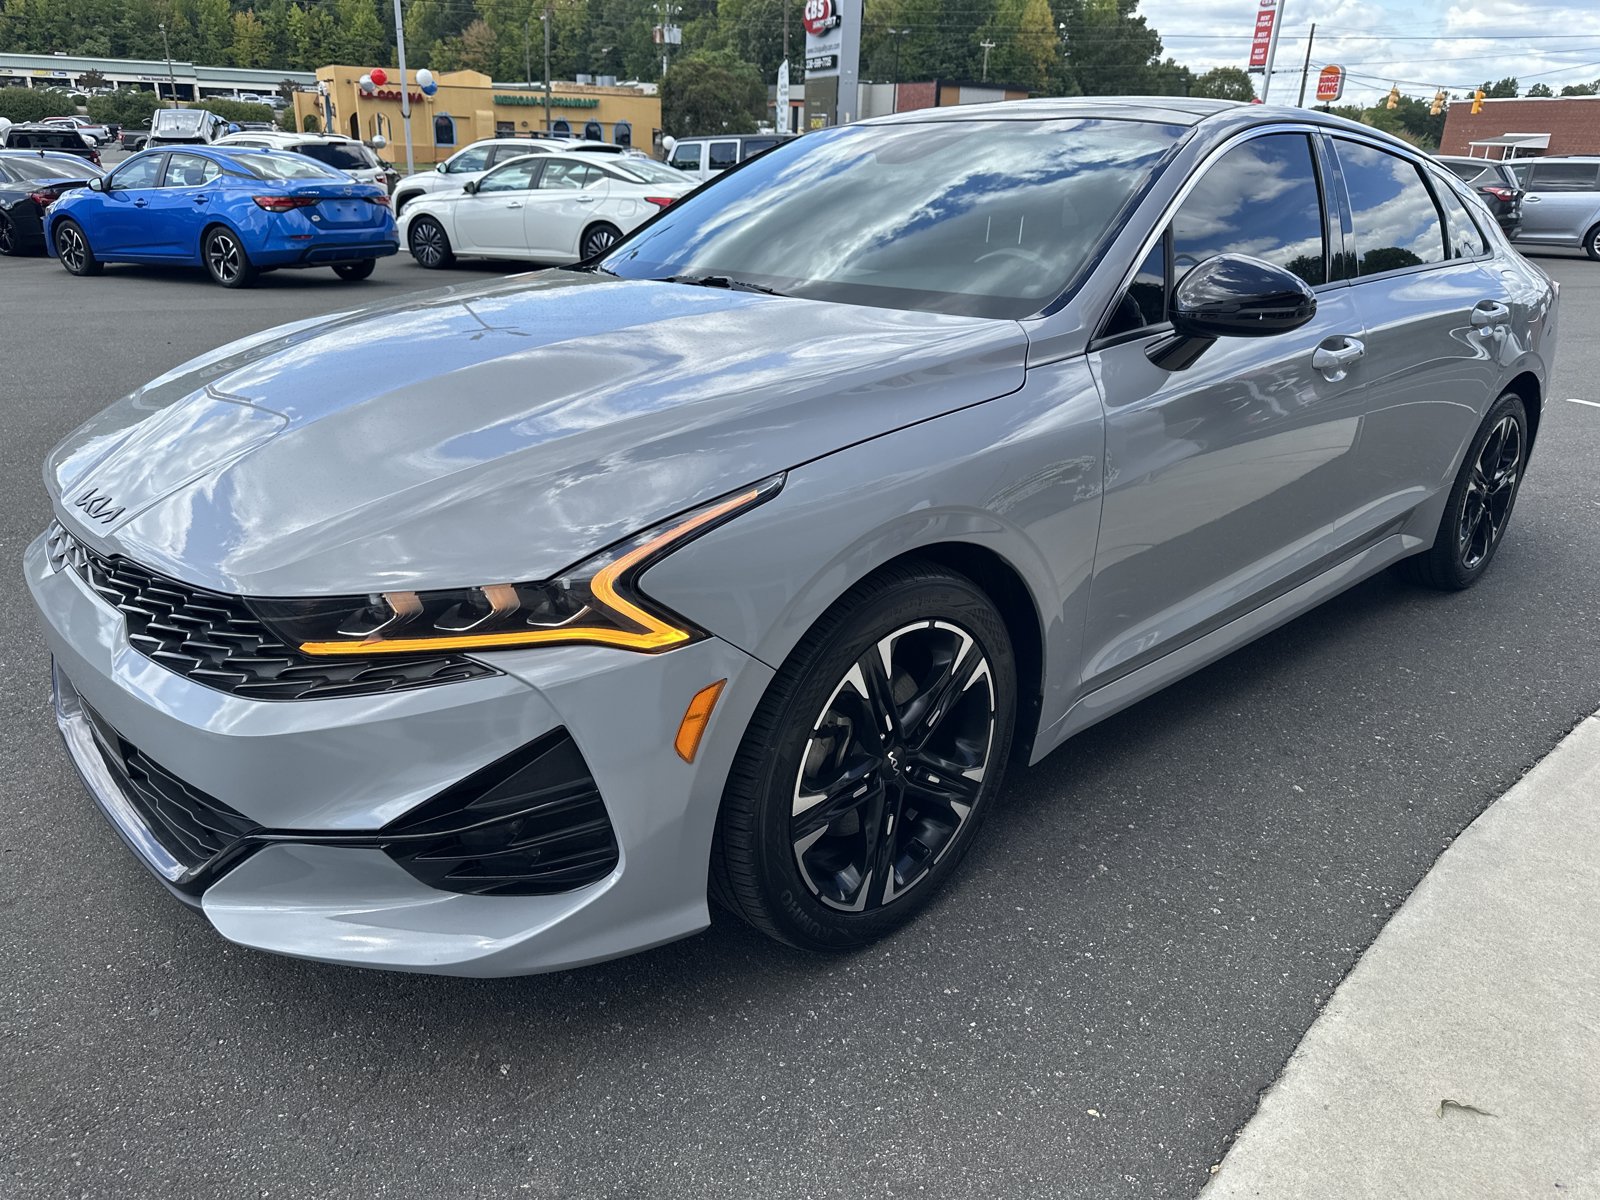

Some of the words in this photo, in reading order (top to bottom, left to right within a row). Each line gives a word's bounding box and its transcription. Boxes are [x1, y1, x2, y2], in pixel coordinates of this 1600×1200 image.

[805, 0, 824, 21] CBS
[1317, 84, 1338, 93] KING
[377, 90, 424, 102] COCNA
[540, 96, 600, 109] RSTAURANT
[780, 888, 834, 940] KUMHO
